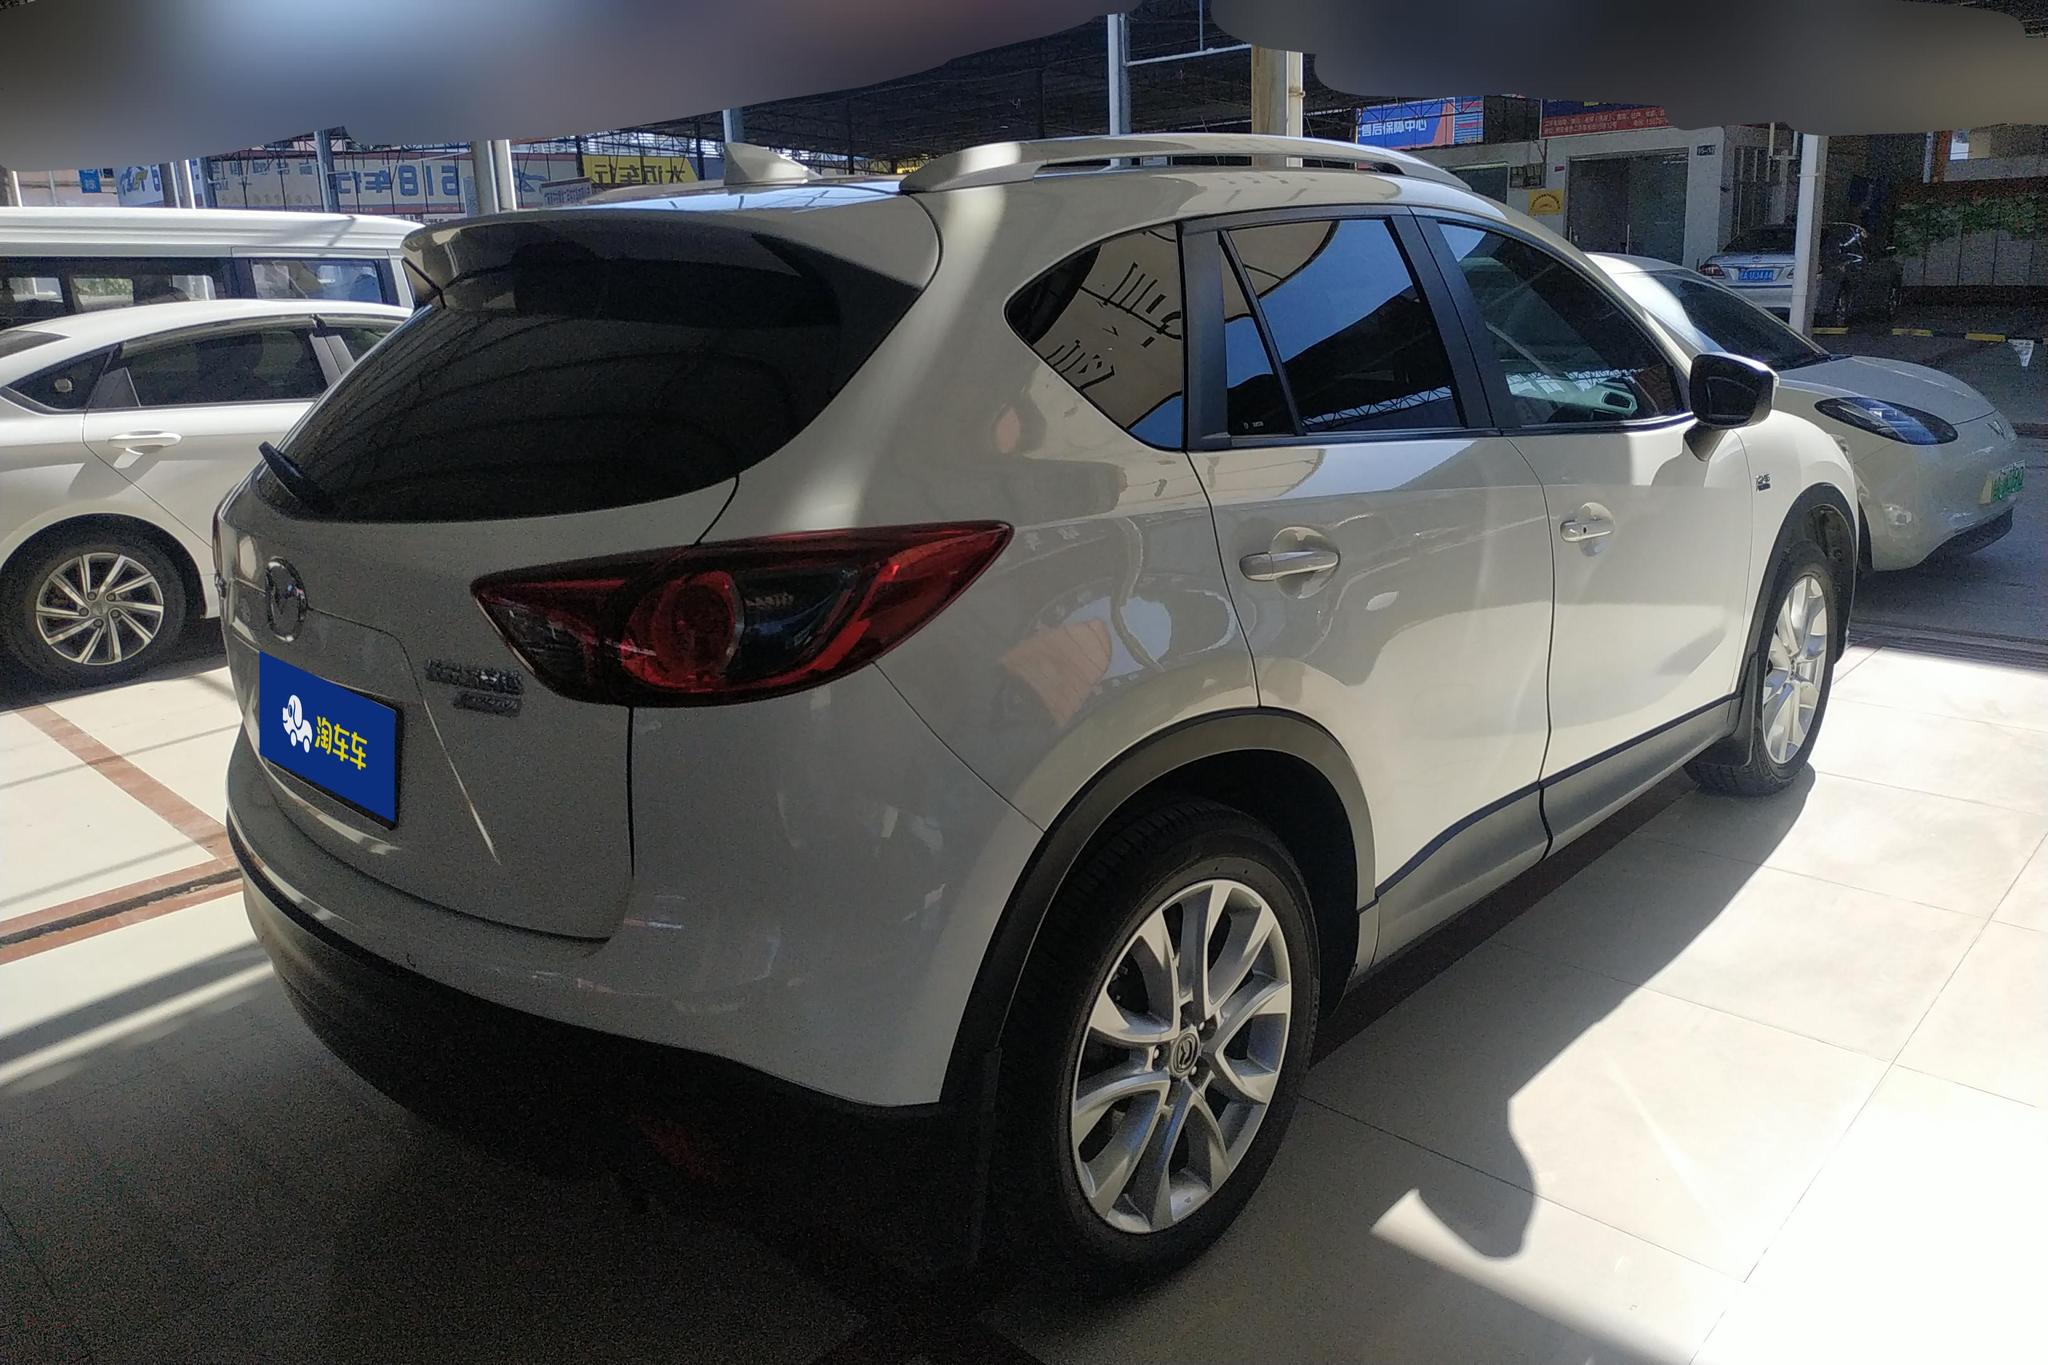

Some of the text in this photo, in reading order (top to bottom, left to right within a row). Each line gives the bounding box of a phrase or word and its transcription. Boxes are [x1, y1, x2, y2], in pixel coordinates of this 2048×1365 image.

[1362, 118, 1427, 137] 售后保障中心
